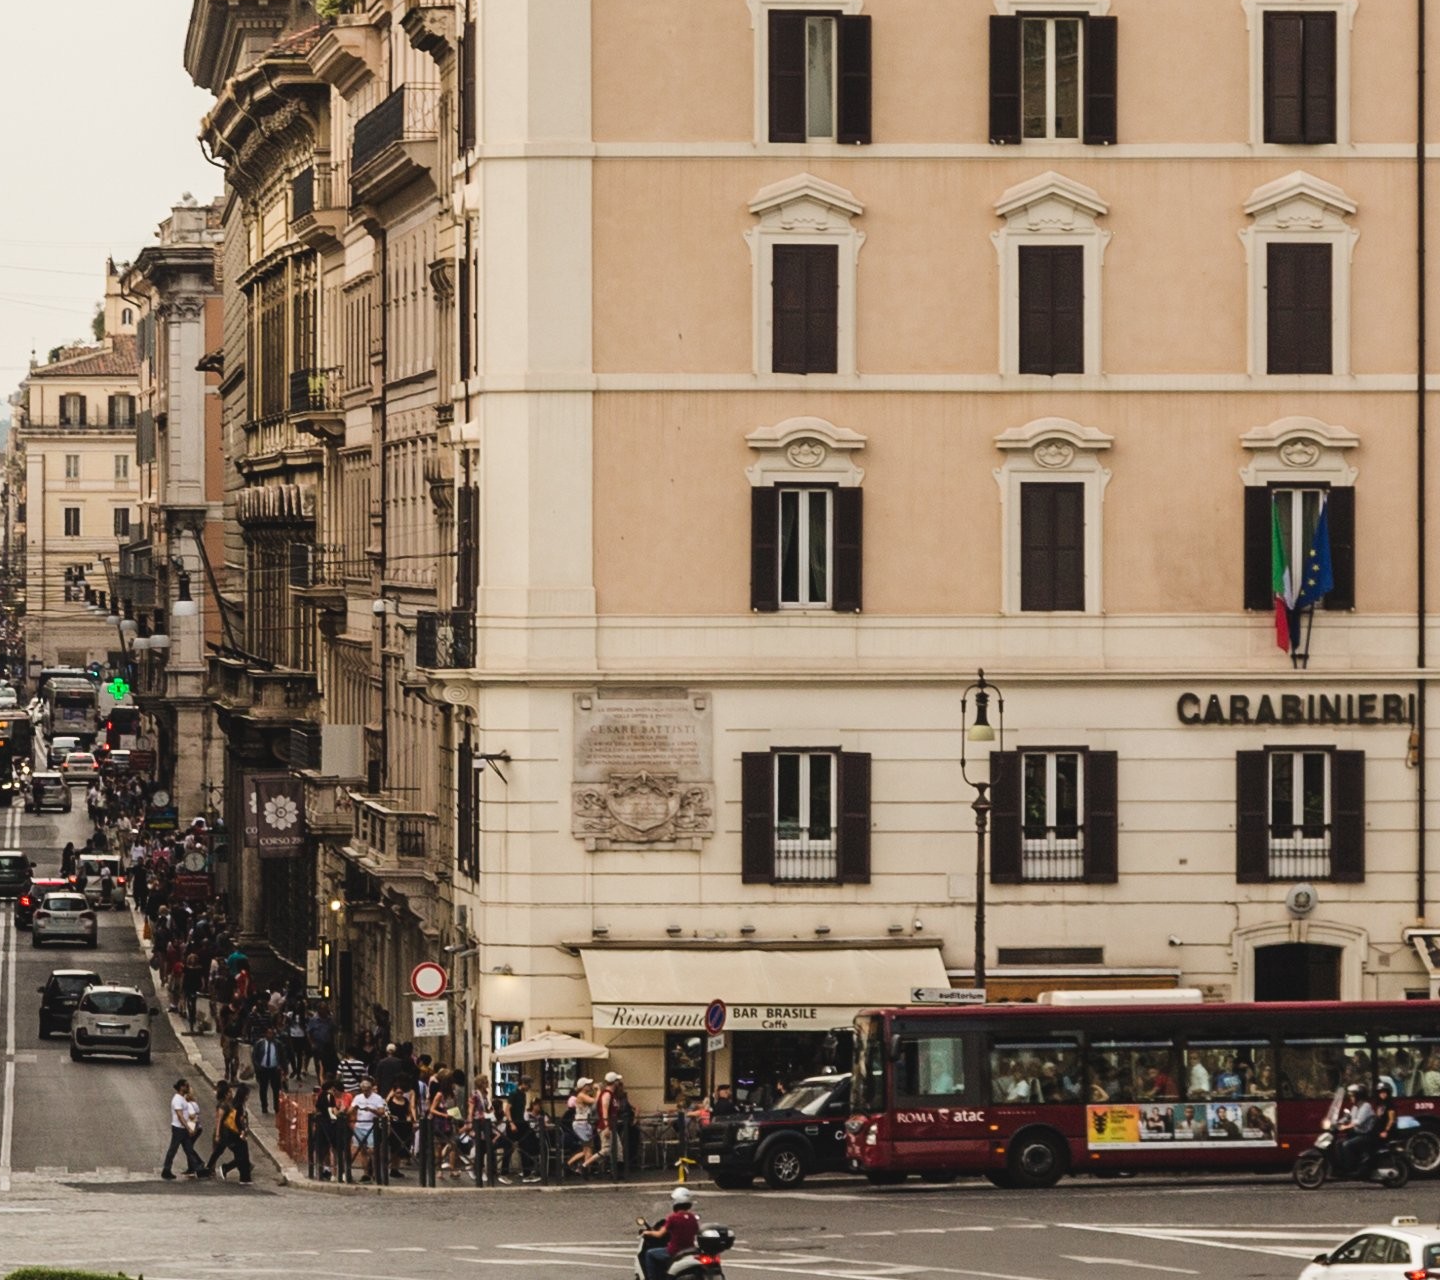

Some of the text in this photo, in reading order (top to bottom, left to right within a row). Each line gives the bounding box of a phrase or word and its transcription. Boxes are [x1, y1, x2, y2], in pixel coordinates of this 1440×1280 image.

[1177, 692, 1415, 725] CARABINIERI
[590, 724, 697, 735] CESARE BATTISTI
[260, 836, 290, 846] CORSO
[938, 991, 985, 1002] auditorium
[611, 1006, 818, 1027] Ristorante BAR BRASILE
[897, 1107, 985, 1124] ROMA atac
